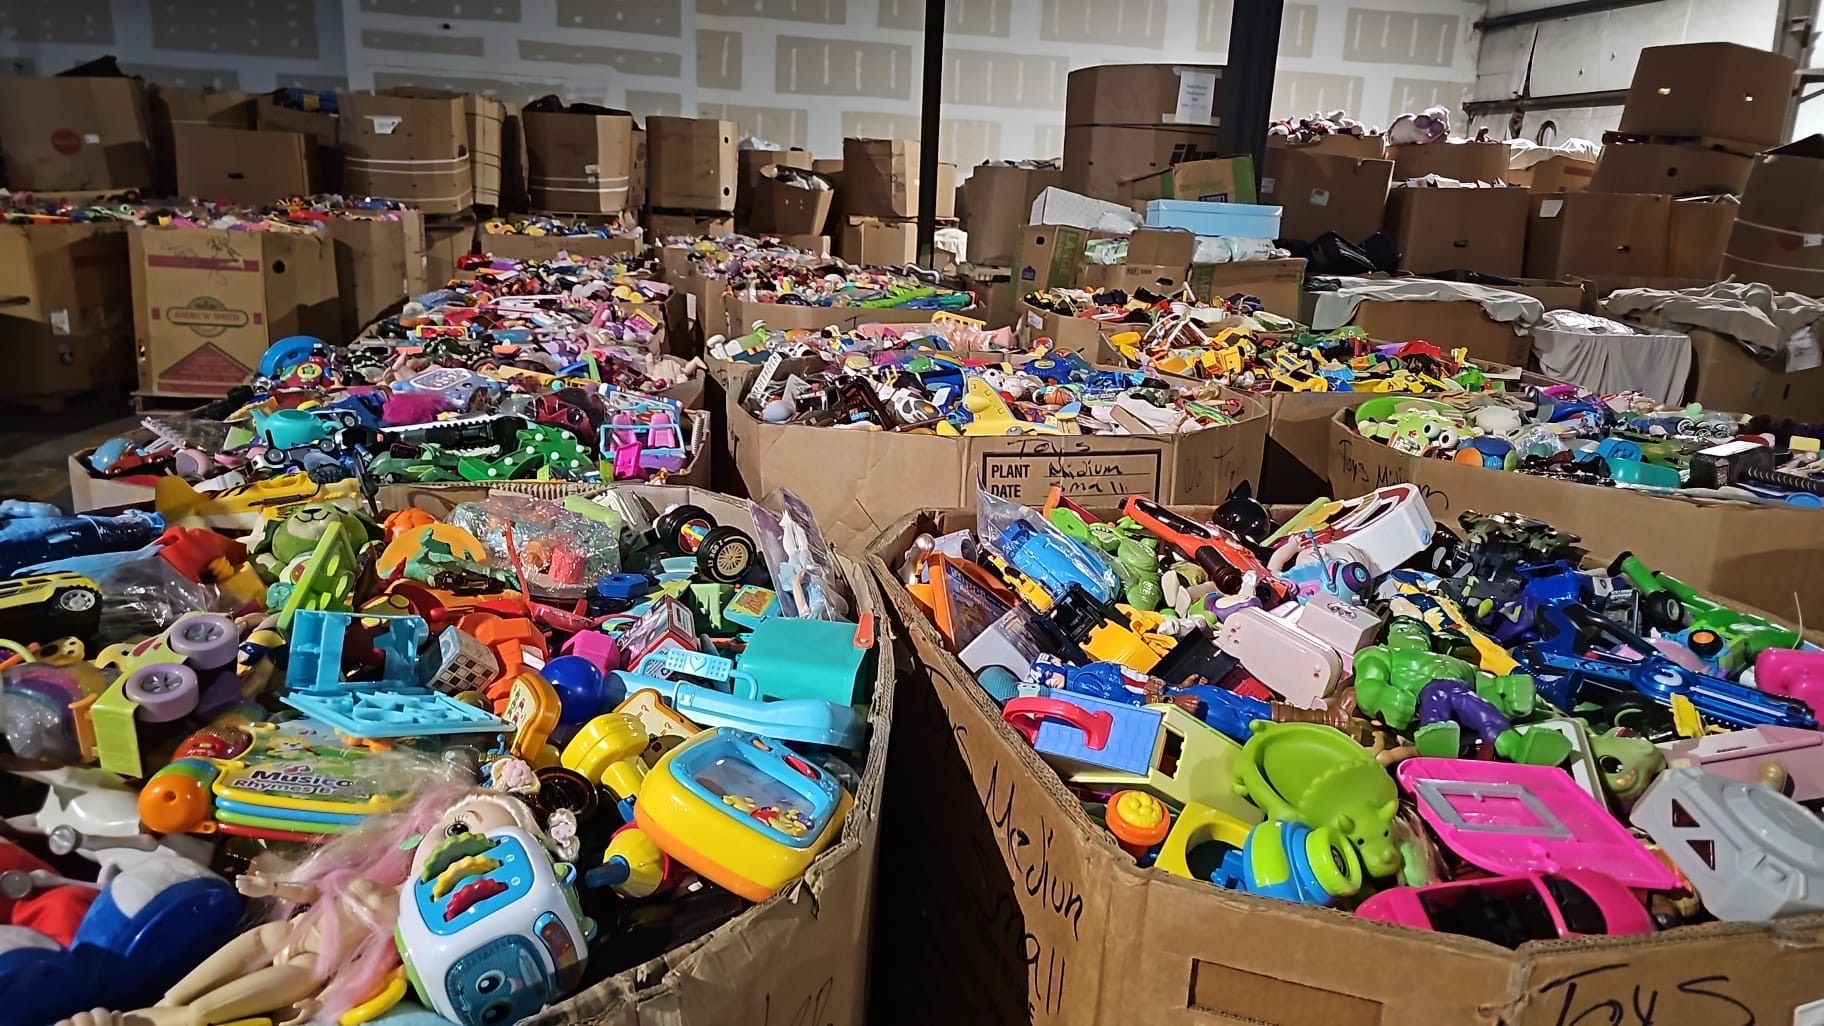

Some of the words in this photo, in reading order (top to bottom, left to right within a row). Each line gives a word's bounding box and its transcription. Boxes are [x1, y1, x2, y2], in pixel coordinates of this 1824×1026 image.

[991, 464, 1031, 479] PLANT
[991, 484, 1022, 498] DATE
[234, 779, 315, 794] Rhymes
